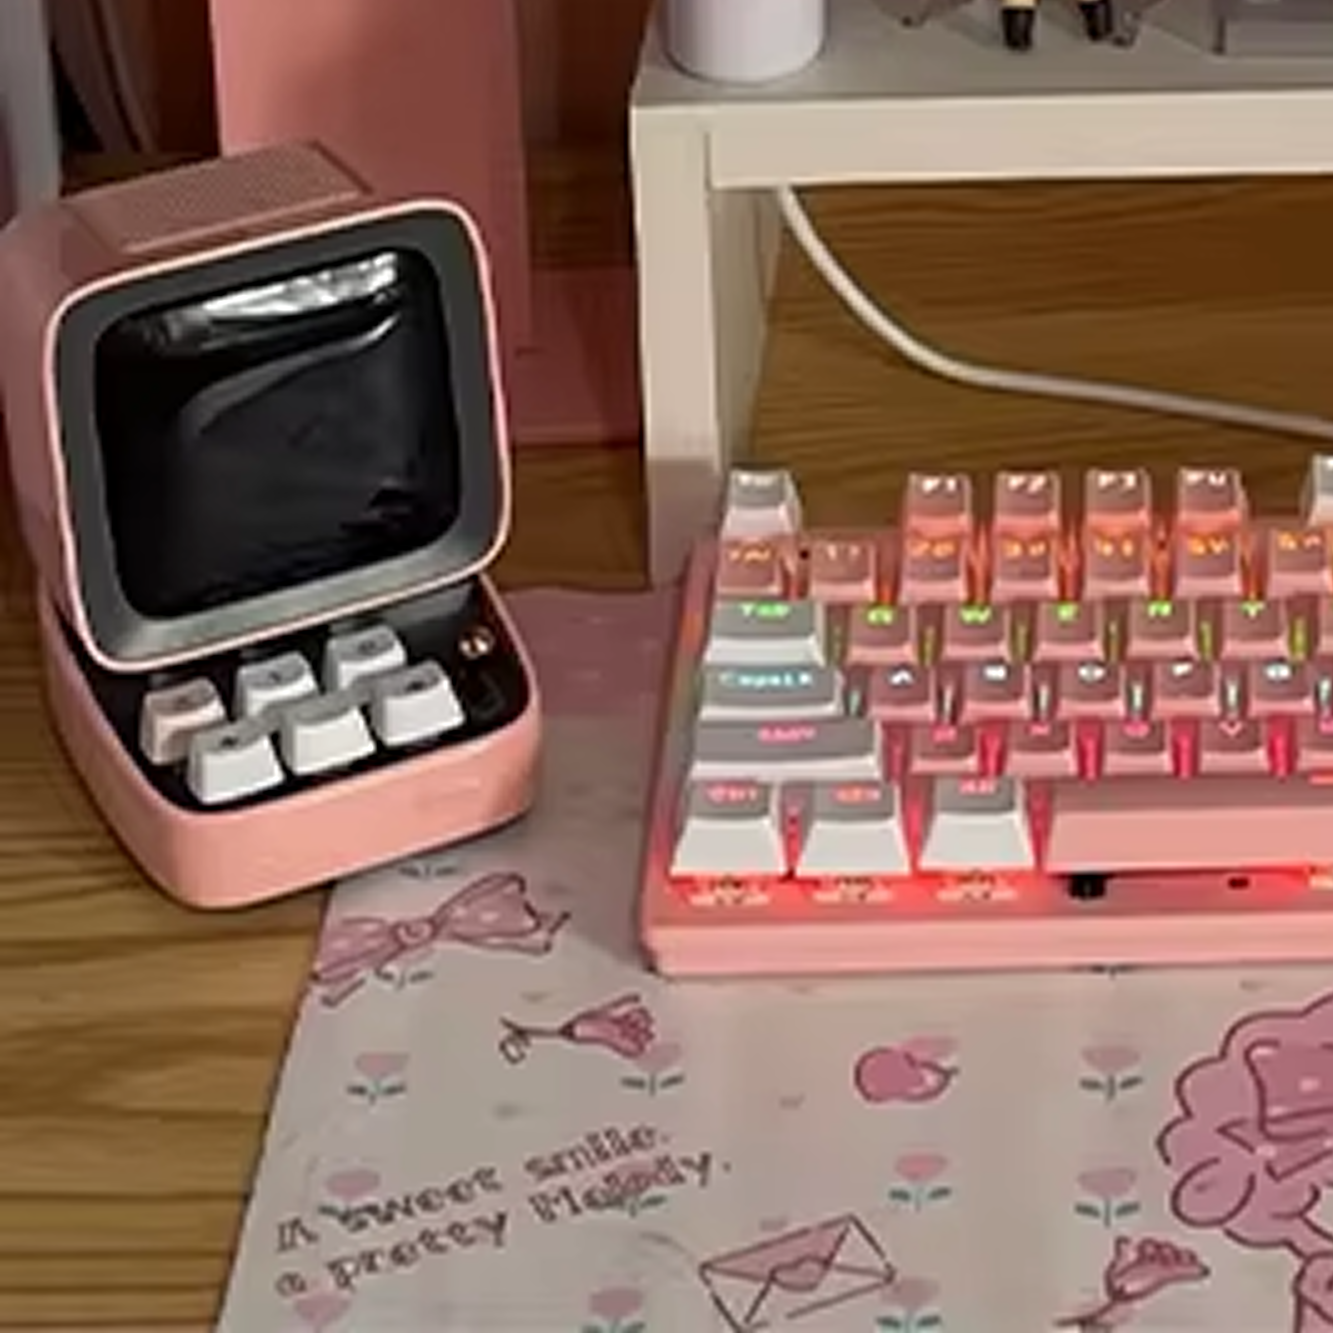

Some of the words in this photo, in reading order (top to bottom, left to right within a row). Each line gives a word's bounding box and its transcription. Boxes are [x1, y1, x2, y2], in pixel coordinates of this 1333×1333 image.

[274, 1270, 309, 1298] a
[326, 1209, 508, 1294] pretty
[528, 1151, 732, 1223] Melody.
[275, 1216, 320, 1254] A
[343, 1165, 503, 1234] sweet
[523, 1126, 670, 1183] smile.
